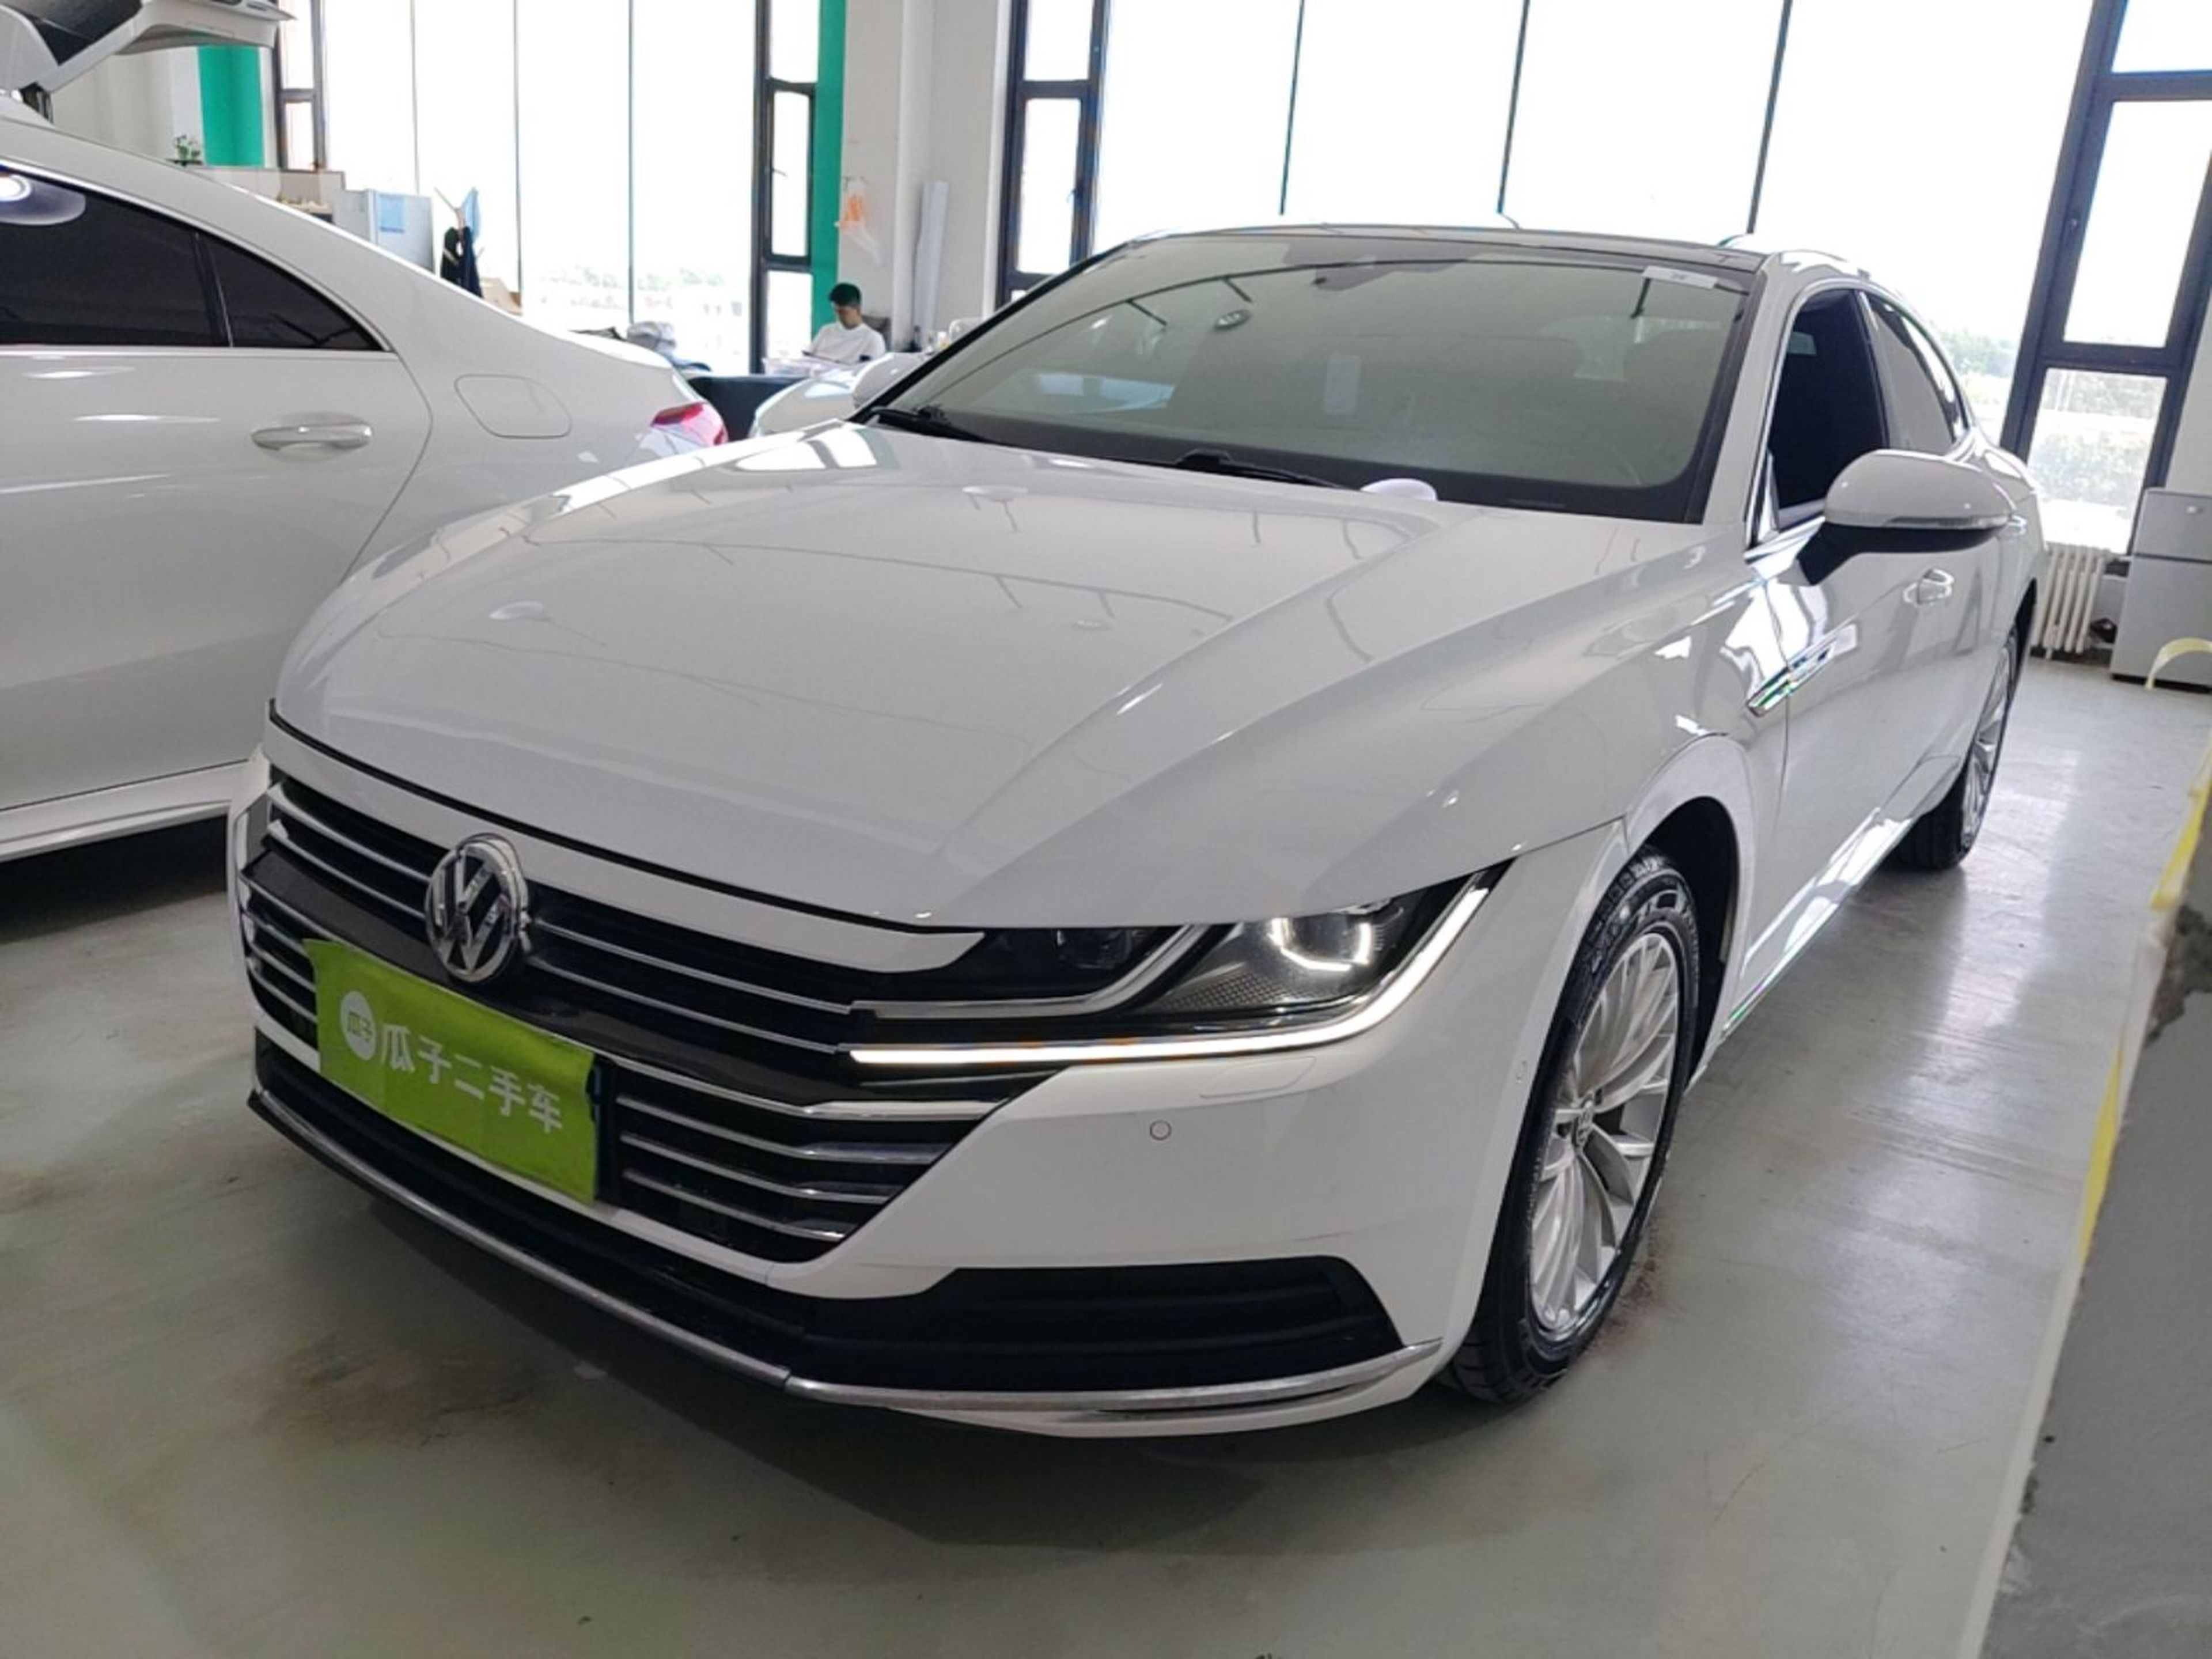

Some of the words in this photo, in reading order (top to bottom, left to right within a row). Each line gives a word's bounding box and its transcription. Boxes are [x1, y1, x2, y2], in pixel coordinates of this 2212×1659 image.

[379, 1023, 563, 1135] 瓜子二手车
